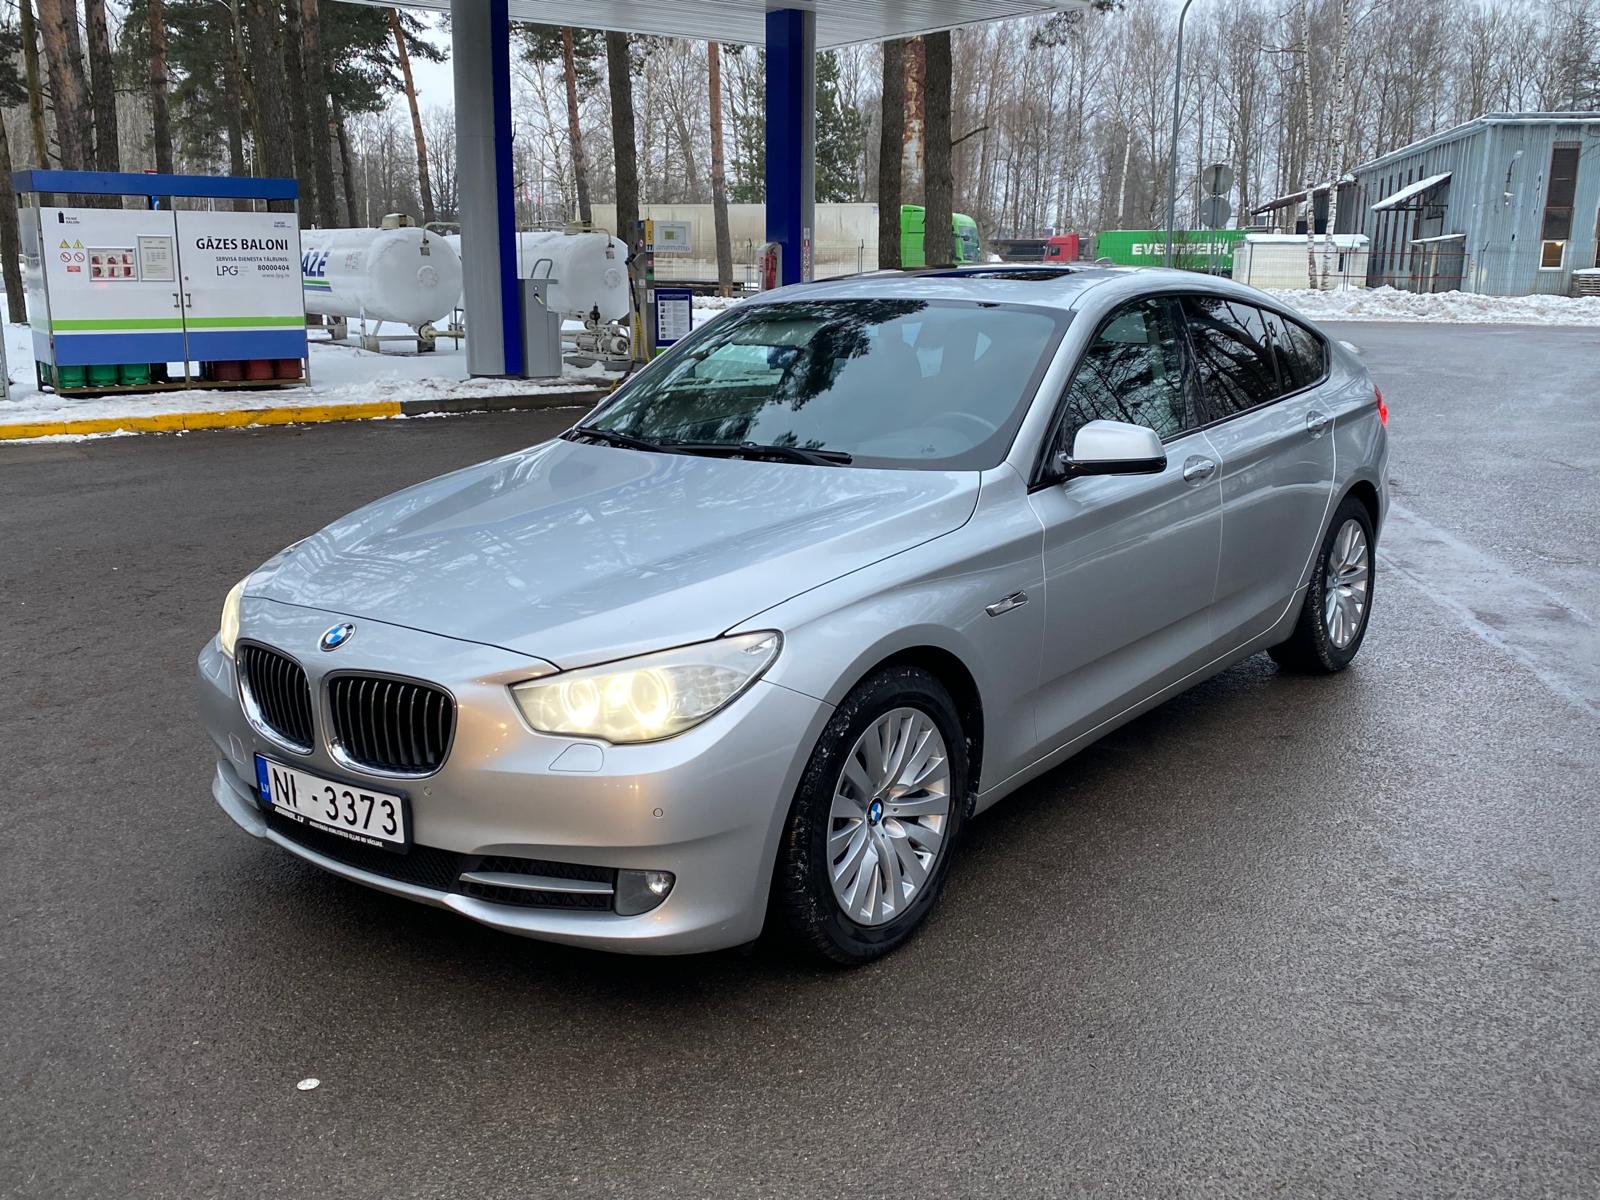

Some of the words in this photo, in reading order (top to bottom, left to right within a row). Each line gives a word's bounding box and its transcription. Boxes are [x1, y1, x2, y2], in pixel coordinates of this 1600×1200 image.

[196, 236, 238, 250] GĀZES
[241, 239, 288, 250] BALONI
[302, 247, 330, 277] ĀZE
[216, 265, 238, 276] LPG
[260, 782, 269, 793] LV
